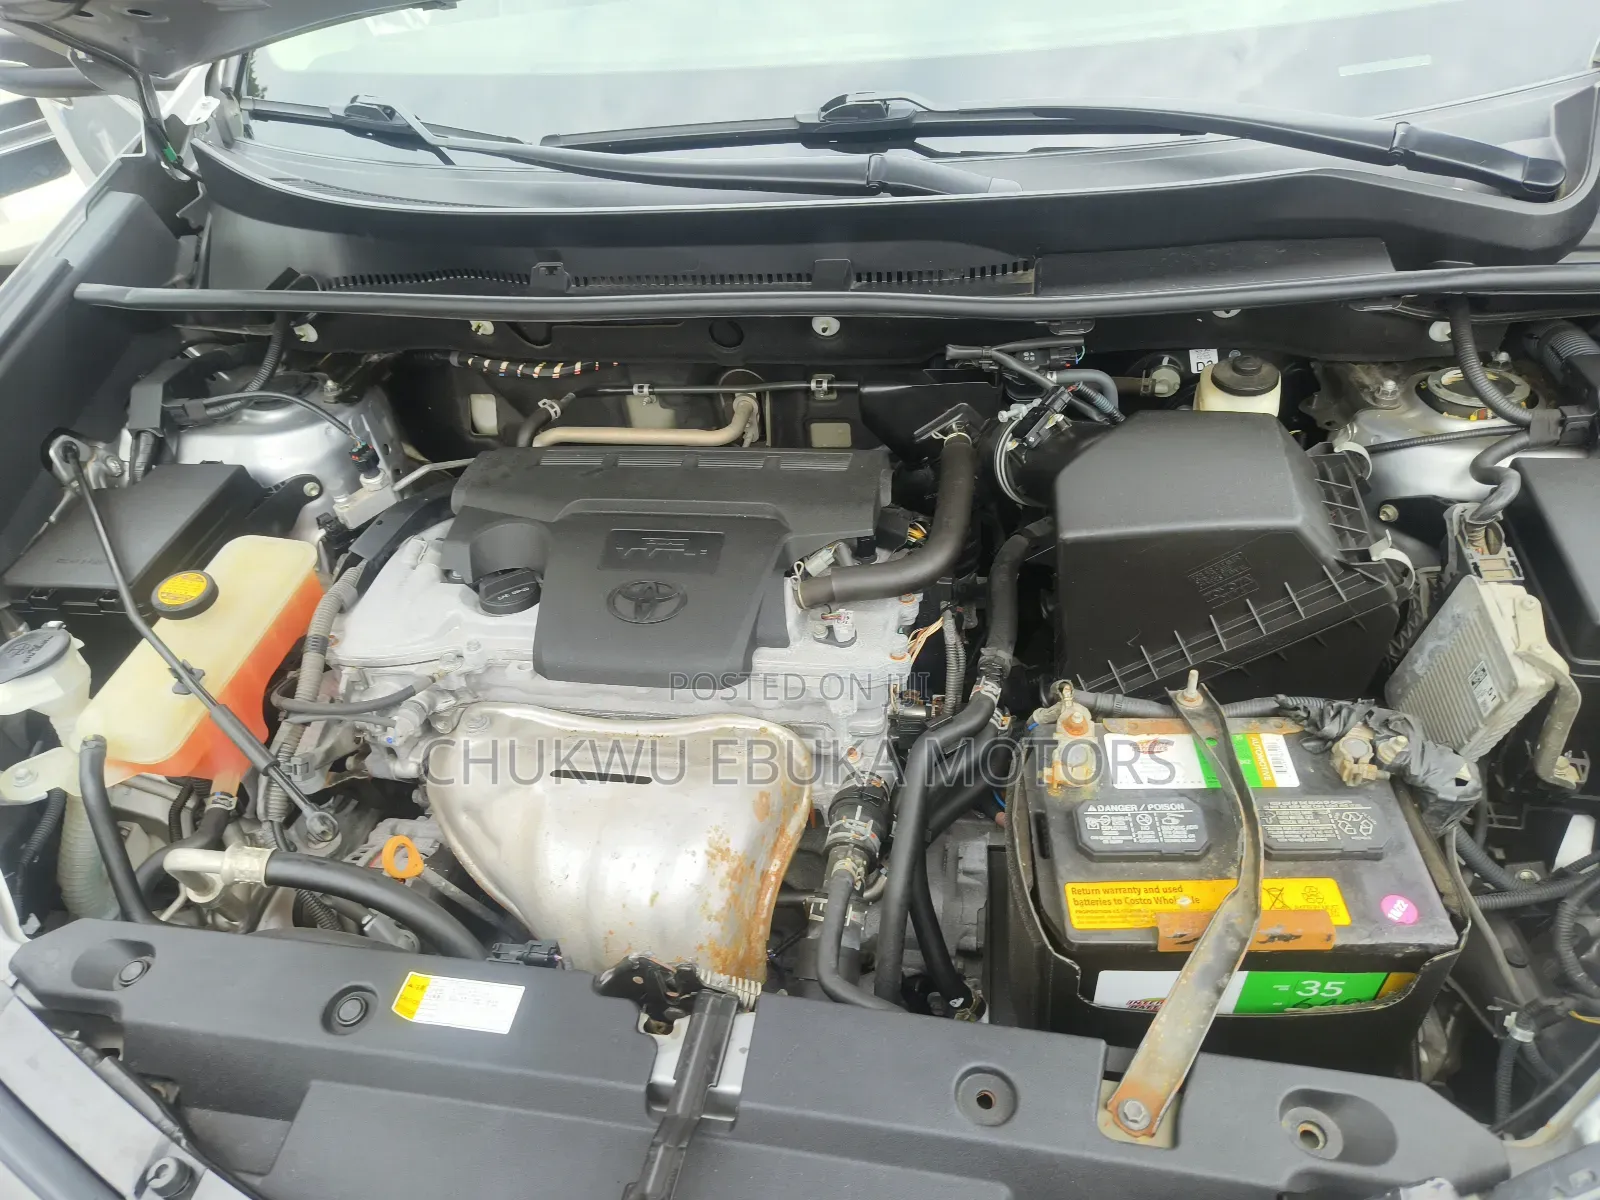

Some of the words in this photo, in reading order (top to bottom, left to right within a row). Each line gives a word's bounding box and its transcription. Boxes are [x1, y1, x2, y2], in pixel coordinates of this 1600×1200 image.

[1251, 737, 1272, 781] AUTOMOTIVE
[1097, 804, 1138, 812] DANGER
[1147, 803, 1185, 811] POISON
[1071, 887, 1100, 895] Return
[1102, 886, 1141, 896] warranty
[1143, 886, 1160, 894] and
[1162, 885, 1184, 893] used
[1073, 898, 1112, 906] batteries
[1113, 897, 1122, 905] to
[1124, 897, 1152, 905] Costco
[1153, 895, 1201, 905] Wholle
[1296, 980, 1346, 997] 35
